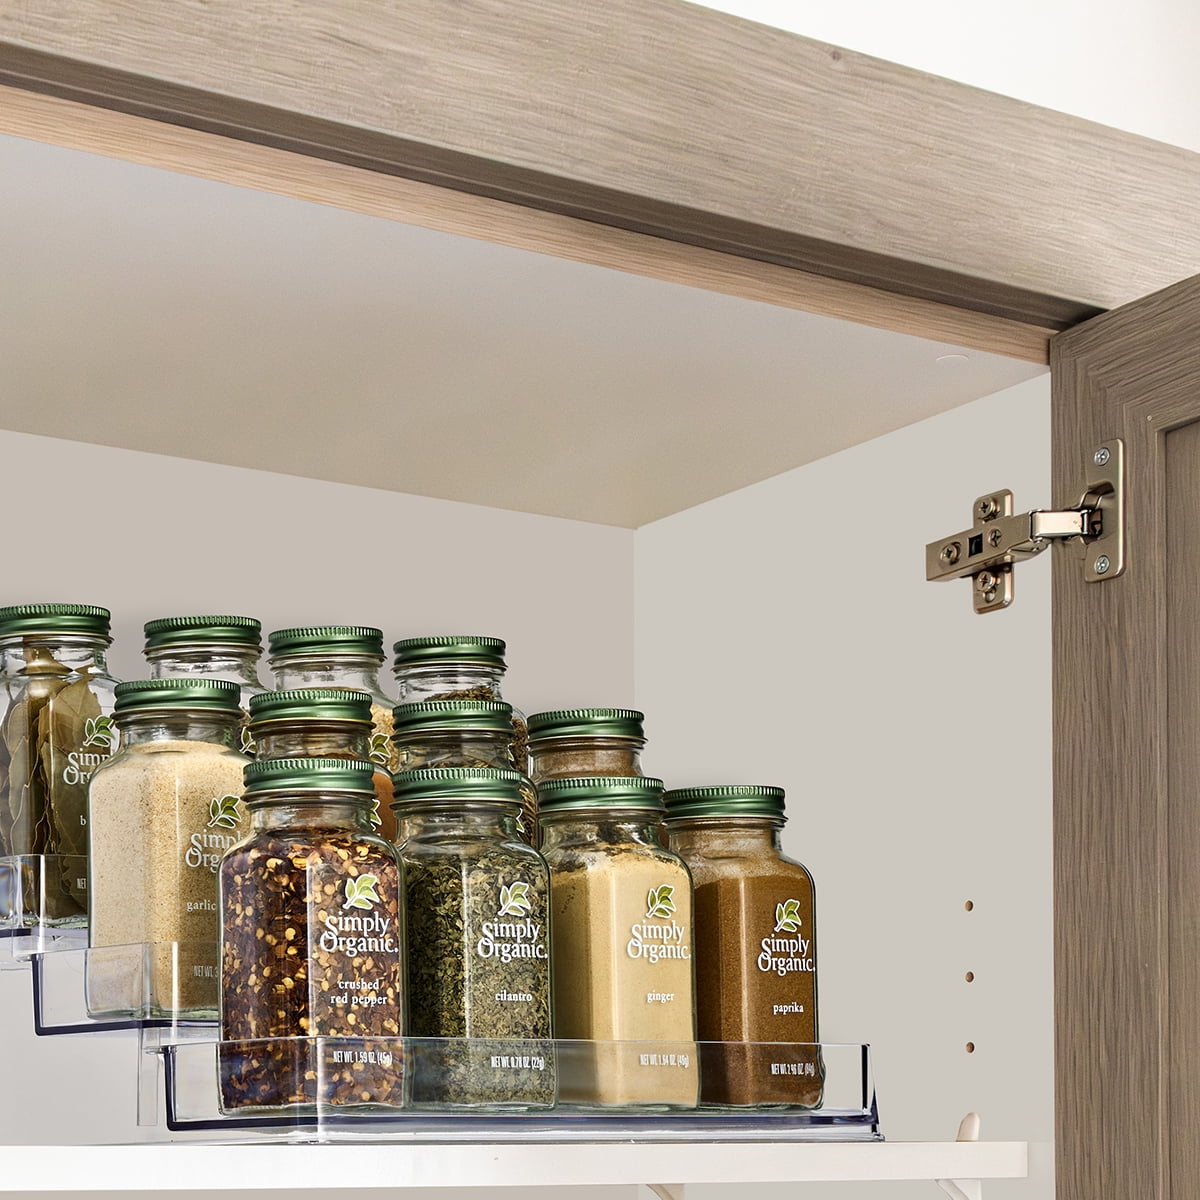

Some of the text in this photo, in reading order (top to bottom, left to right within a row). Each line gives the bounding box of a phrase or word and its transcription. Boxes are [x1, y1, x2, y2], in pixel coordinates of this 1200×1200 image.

[186, 899, 217, 912] garlic
[325, 911, 390, 937] Simply
[482, 918, 540, 944] Simply
[631, 920, 685, 943] Simply
[761, 934, 810, 957] Simply
[338, 979, 380, 990] crushed
[331, 993, 387, 1007] red pepper
[495, 991, 533, 1002] cilantro
[647, 991, 675, 1003] ginger
[773, 1002, 804, 1015] paprika
[333, 1051, 345, 1063] NET
[491, 1056, 501, 1068] NET
[639, 1054, 649, 1066] NET
[771, 1063, 779, 1075] NET
